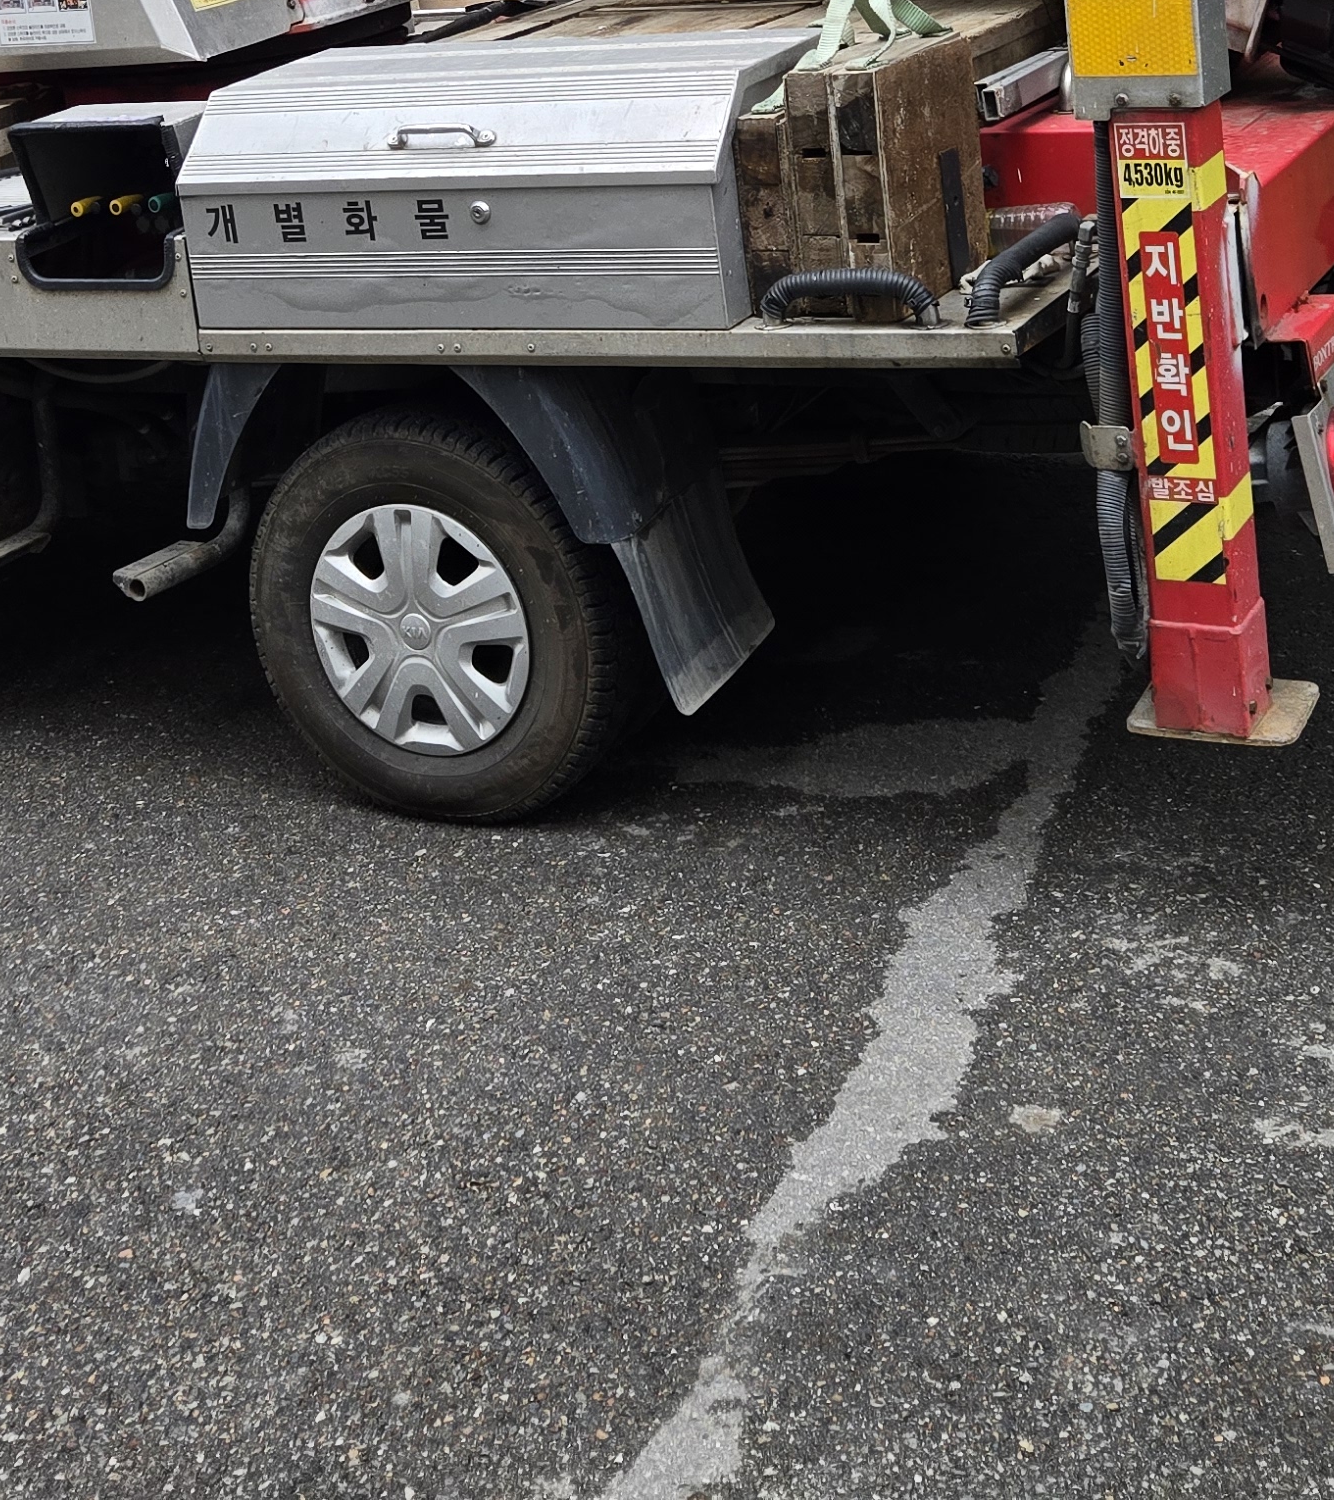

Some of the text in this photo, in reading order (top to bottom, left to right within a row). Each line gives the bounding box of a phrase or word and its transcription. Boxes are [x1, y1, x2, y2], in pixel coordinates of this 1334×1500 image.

[1119, 128, 1181, 157] 정격하중
[1123, 163, 1184, 188] 4,530kg
[401, 624, 427, 638] KIA
